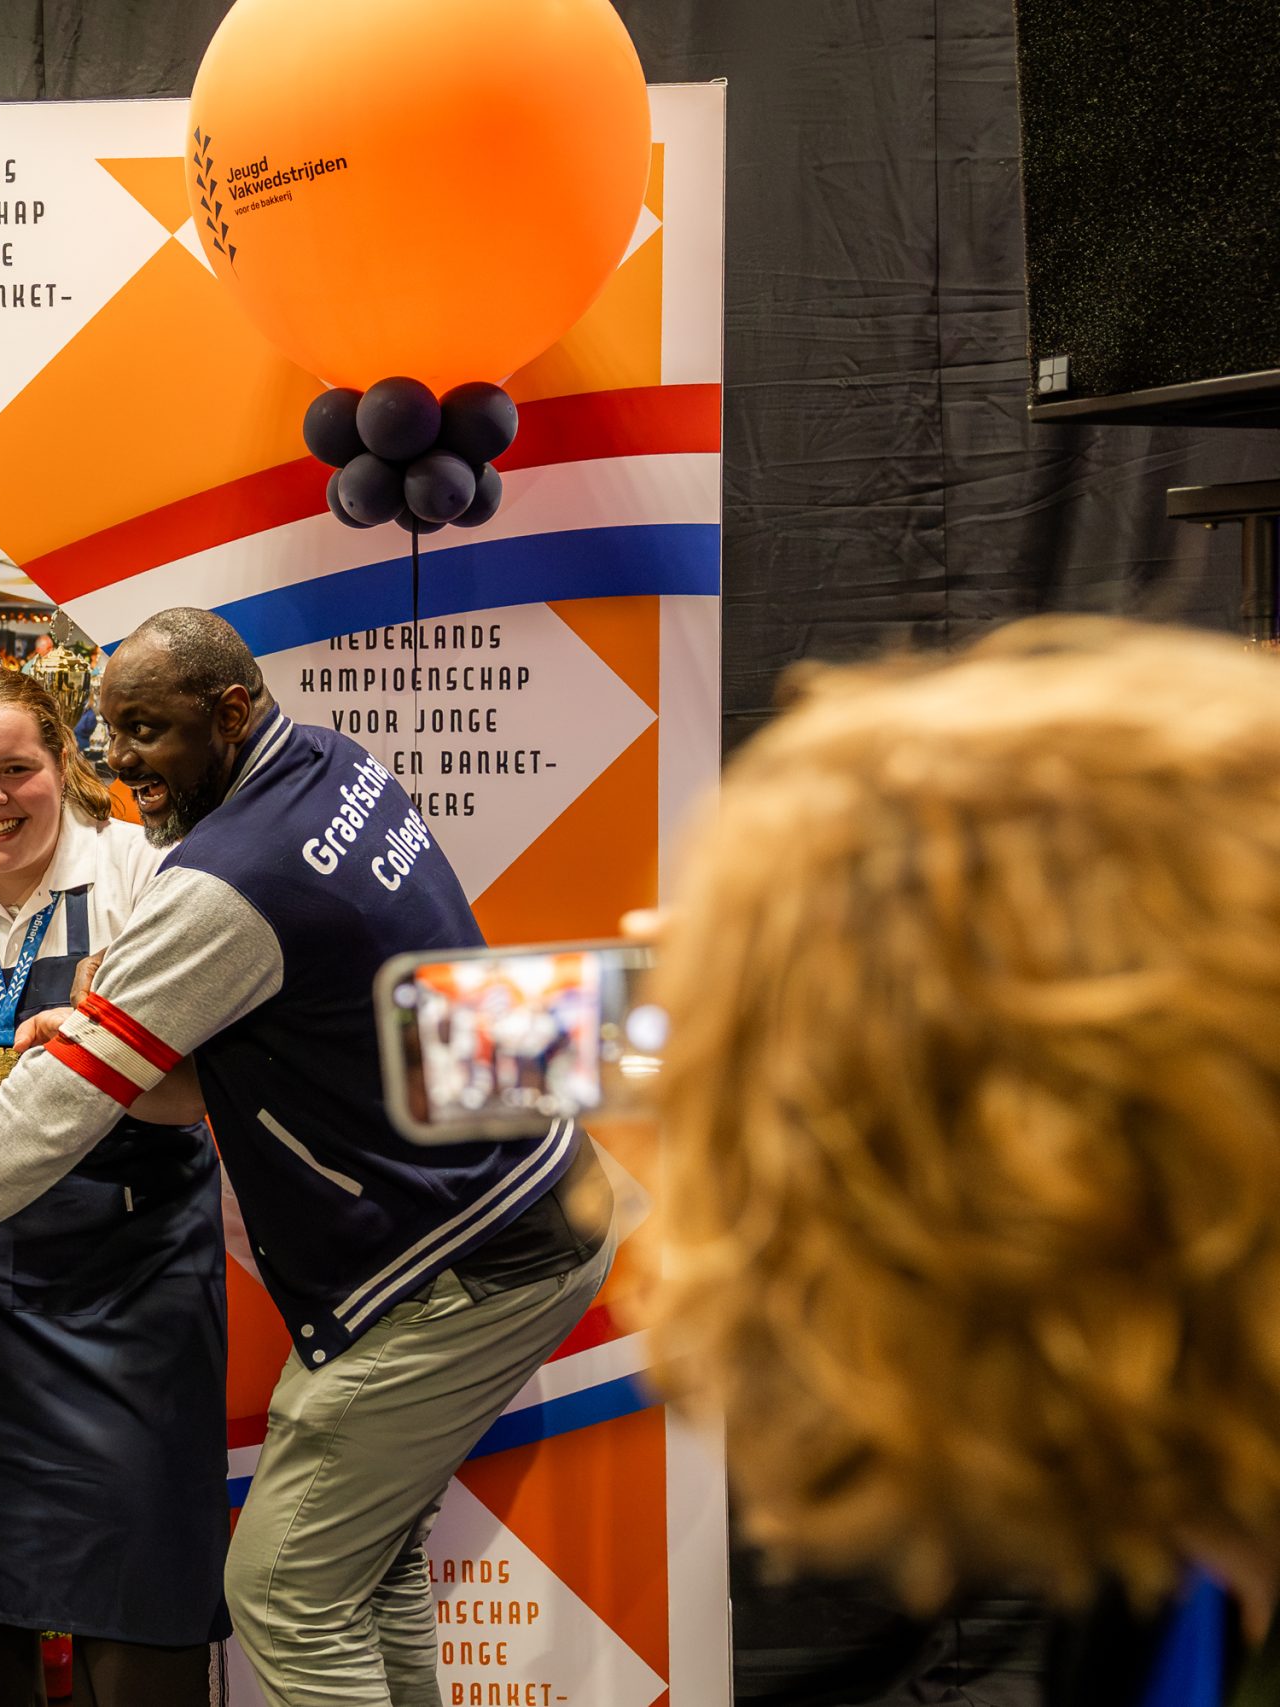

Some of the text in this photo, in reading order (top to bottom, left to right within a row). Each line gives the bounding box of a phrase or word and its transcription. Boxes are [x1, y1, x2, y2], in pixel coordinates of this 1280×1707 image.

[227, 155, 269, 184] Jeugd
[228, 156, 348, 201] Vakwedstrijden
[234, 189, 293, 216] voor de bakkerij
[329, 624, 502, 651] NEDERLANDS
[300, 666, 530, 692] KAMPIOENSCHAP
[332, 708, 498, 734] VOOR JONGE
[393, 750, 557, 775] EN BANKET-
[302, 752, 395, 875] Graafscha
[411, 792, 476, 817] KERS
[371, 807, 431, 892] College
[428, 1559, 510, 1584] LANDS
[437, 1600, 540, 1625] NSCHAP
[442, 1641, 508, 1666] ONGE
[451, 1682, 568, 1707] BANKET-
